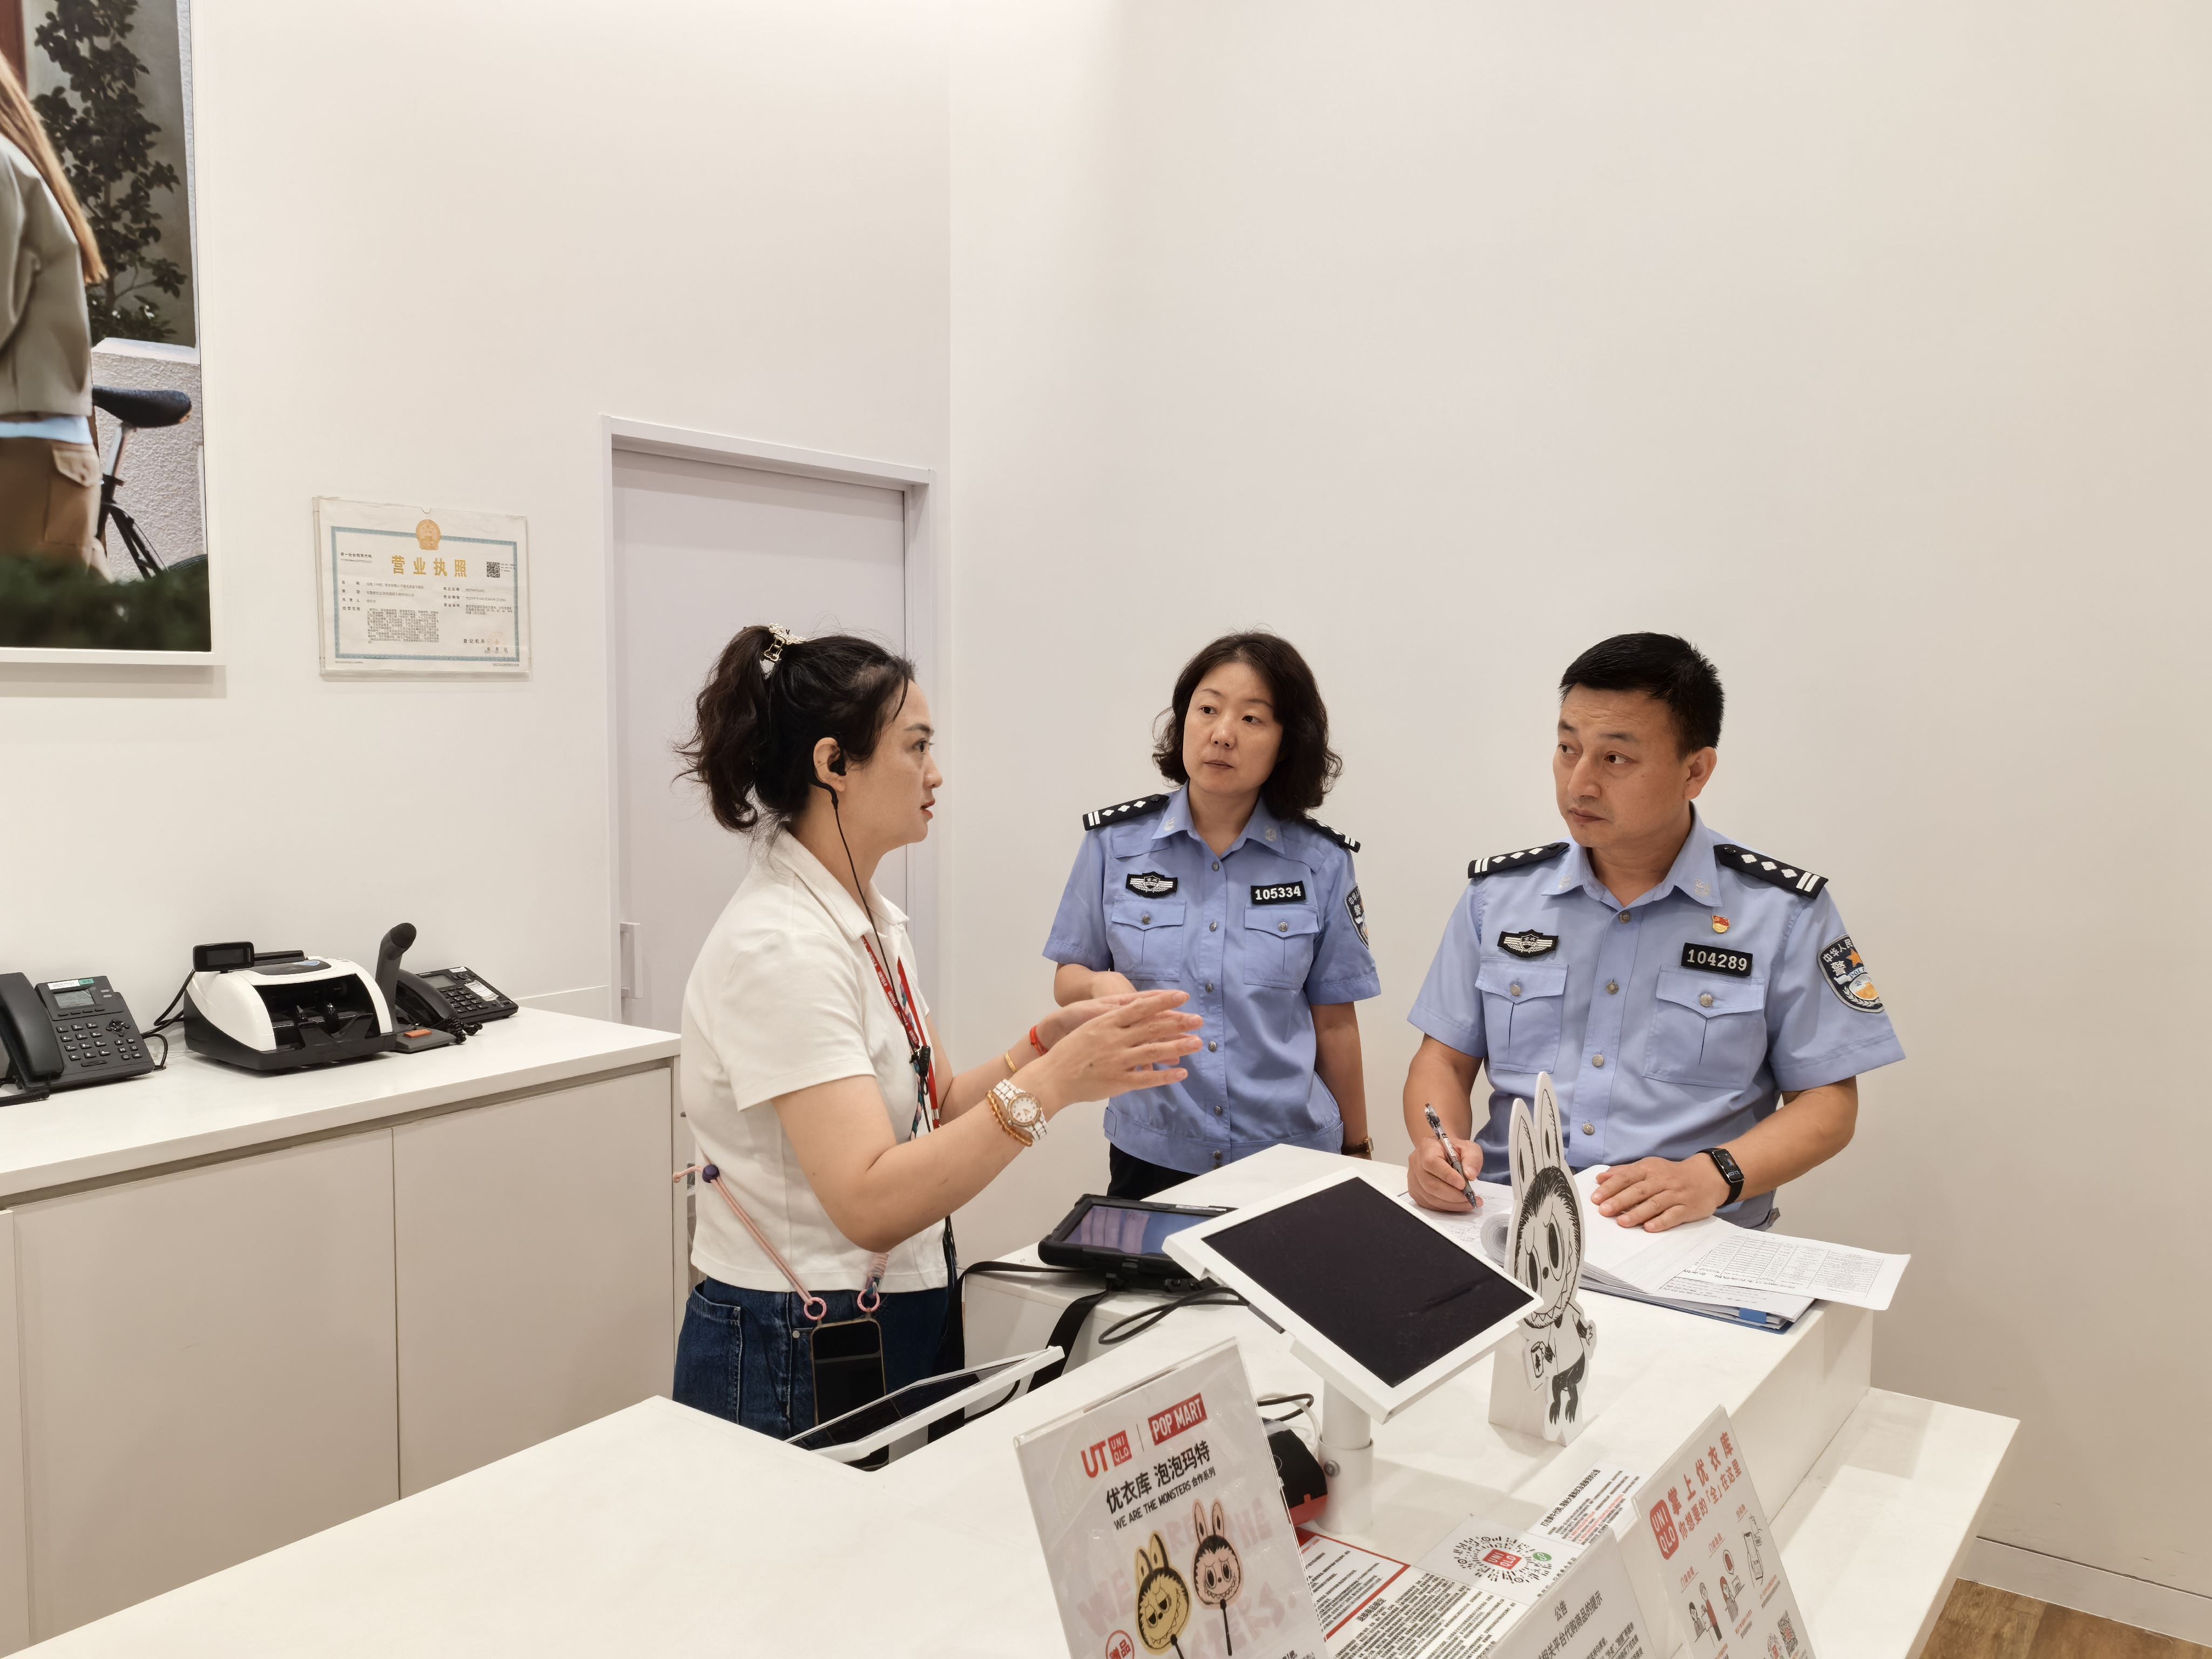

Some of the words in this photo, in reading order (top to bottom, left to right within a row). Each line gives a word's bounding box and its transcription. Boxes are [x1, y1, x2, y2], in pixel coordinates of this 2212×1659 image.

[390, 555, 468, 577] 营业执照
[1255, 886, 1301, 900] 105334
[1687, 949, 1747, 971] 104289
[1831, 960, 1846, 976] 警
[877, 970, 888, 987] UNIQLO
[887, 990, 898, 1007] UNIQLO
[1151, 1414, 1172, 1441] POP
[1174, 1398, 1203, 1429] MART
[1110, 1435, 1125, 1449] UNI
[1081, 1440, 1108, 1478] UT
[1114, 1448, 1131, 1462] QLO
[1107, 1472, 1152, 1514] 优衣库
[1154, 1440, 1210, 1488] 泡泡玛特
[1667, 1431, 1734, 1516] 掌上优衣库
[1114, 1515, 1128, 1530] WE
[1129, 1507, 1143, 1523] ARE
[1143, 1498, 1158, 1514] THE
[1158, 1480, 1192, 1507] MONSTERS
[1191, 1466, 1216, 1488] 合作系列
[1651, 1506, 1668, 1532] UNI
[1660, 1526, 1676, 1554] QLO
[1487, 1551, 1505, 1563] UNI
[1500, 1555, 1517, 1567] QLO
[1554, 1600, 1568, 1622] 公告
